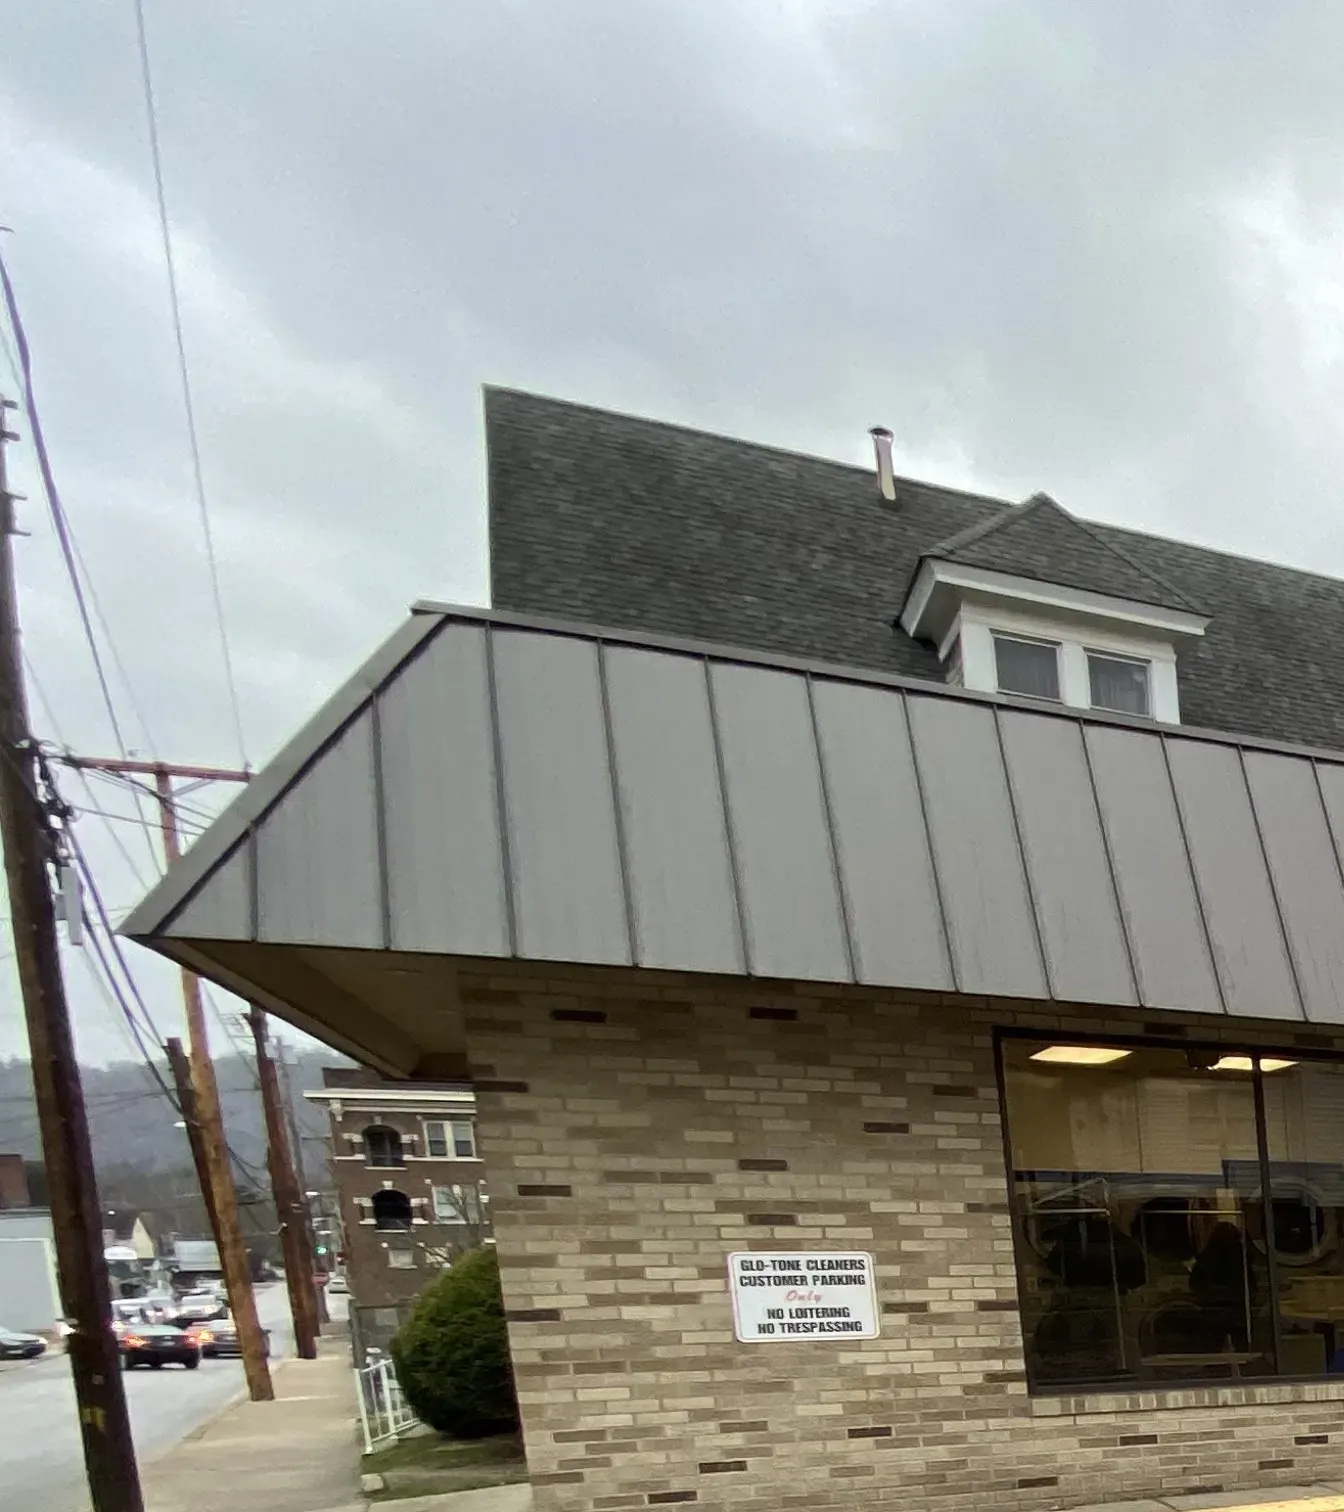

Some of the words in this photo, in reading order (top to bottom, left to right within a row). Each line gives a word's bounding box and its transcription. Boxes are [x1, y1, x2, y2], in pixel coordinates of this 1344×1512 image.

[740, 1259, 801, 1272] GLO-TONE
[806, 1259, 866, 1271] CLEANERS
[740, 1275, 808, 1287] CUSTOMER
[812, 1274, 866, 1286] PARKING
[784, 1289, 822, 1303] Only
[766, 1307, 784, 1320] NO
[788, 1306, 850, 1319] LOITERING
[757, 1322, 775, 1334] NO
[779, 1320, 862, 1334] TRESPASSING
